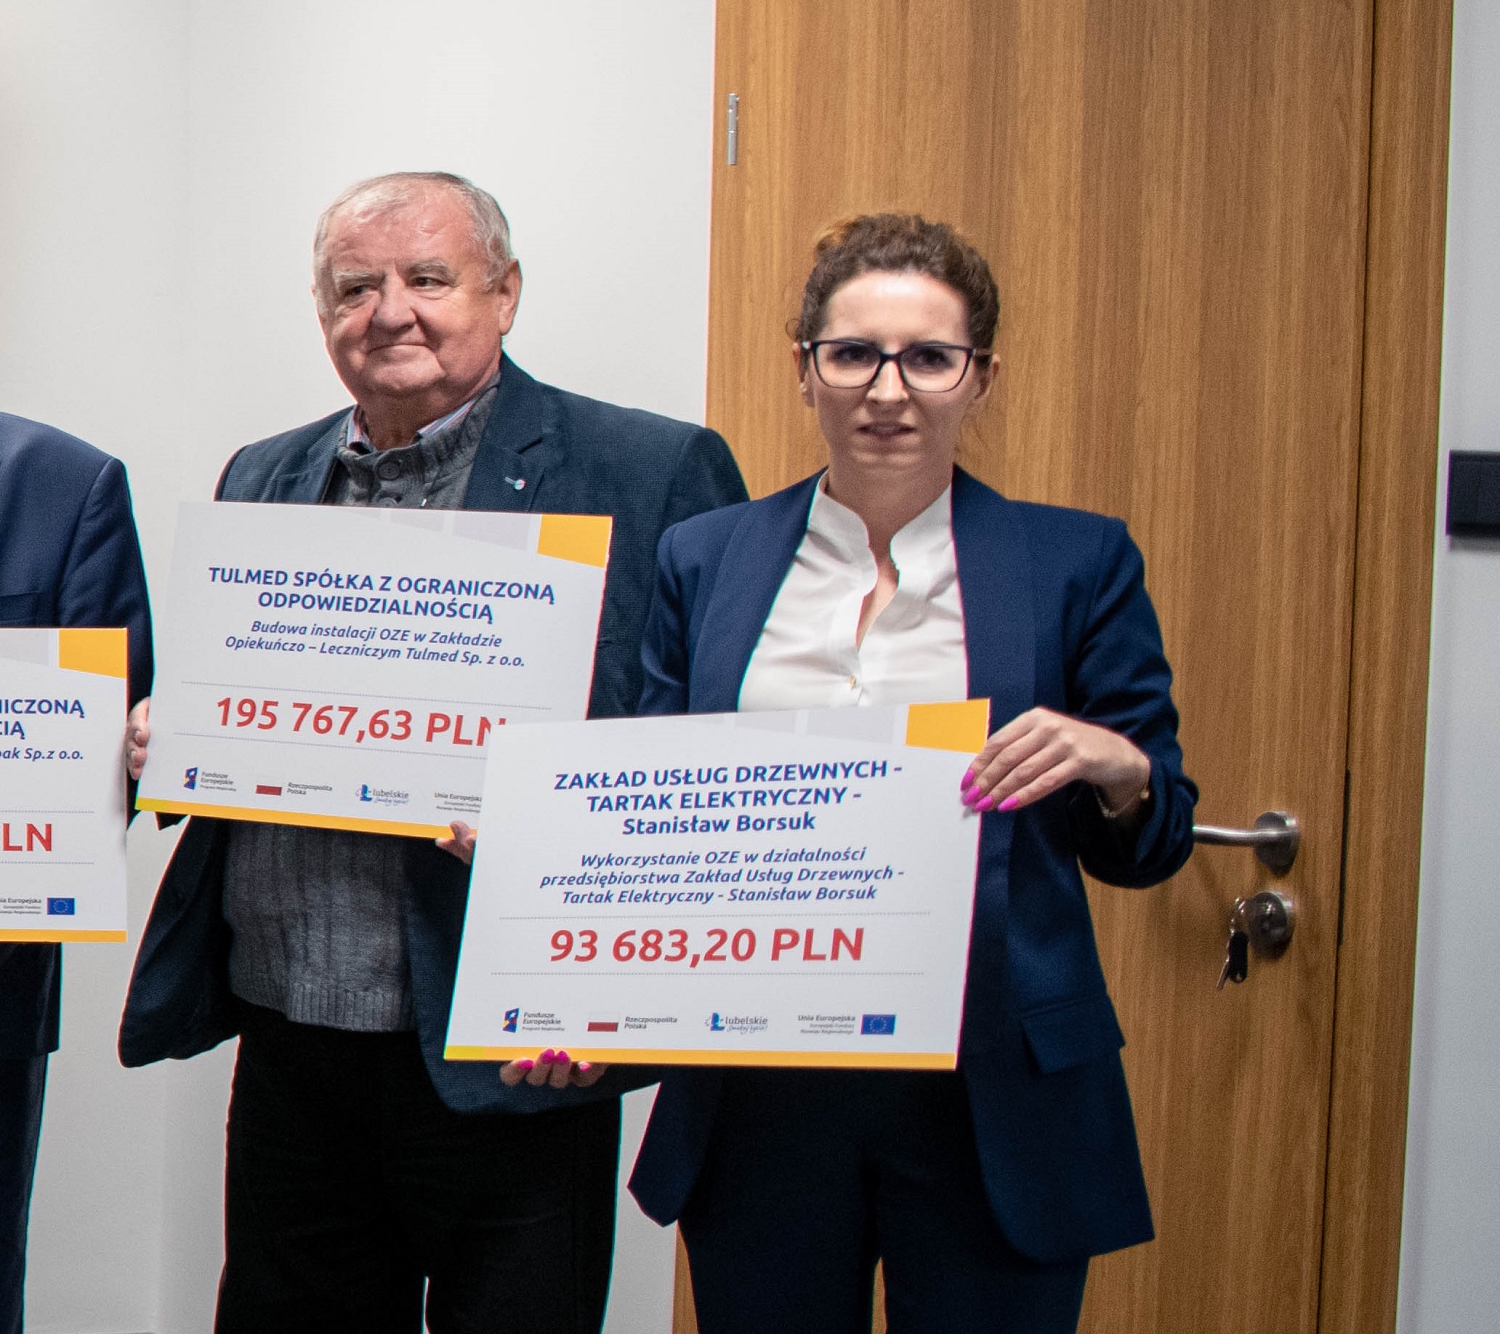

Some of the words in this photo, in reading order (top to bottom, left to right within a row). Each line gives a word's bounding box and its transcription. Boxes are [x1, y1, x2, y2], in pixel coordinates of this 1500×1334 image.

[208, 567, 289, 586] TULMED
[292, 567, 374, 591] SPÓŁKA
[396, 576, 555, 606] OGRANICZONĄ
[257, 591, 494, 625] ODPOWIEDZIALNOŚCIĄ
[250, 620, 308, 636] Budowa
[310, 623, 378, 642] instalacji
[379, 628, 412, 642] OZE
[428, 631, 503, 648] Zakładzie
[225, 635, 306, 653] Opiekuńczo
[319, 641, 402, 661] Leczniczym
[406, 647, 460, 663] Tulmed
[217, 697, 279, 730] 195
[292, 702, 413, 744] 767,63
[554, 770, 648, 790] ZAKŁAD
[653, 766, 729, 787] USŁUG
[735, 760, 888, 783] DRZEWNYCH
[586, 793, 674, 812] TARTAK
[679, 786, 848, 809] ELEKTRYCZNY
[622, 814, 731, 835] Stanisław
[736, 811, 816, 832] Borsuk
[581, 851, 701, 870] Wykorzystanie
[704, 850, 741, 865] OZE
[762, 846, 867, 863] działalności
[539, 871, 681, 889] przedsiębiorstwa
[683, 868, 744, 884] Zakład
[745, 867, 794, 885] Usług
[796, 865, 894, 883] Drzewnych
[563, 889, 615, 904] Tartak
[617, 888, 715, 906] Elektryczny
[727, 886, 813, 902] Stanisław
[815, 884, 878, 901] Borsuk
[550, 929, 598, 963] 93
[612, 928, 757, 969] 683,20
[770, 927, 864, 961] PLN
